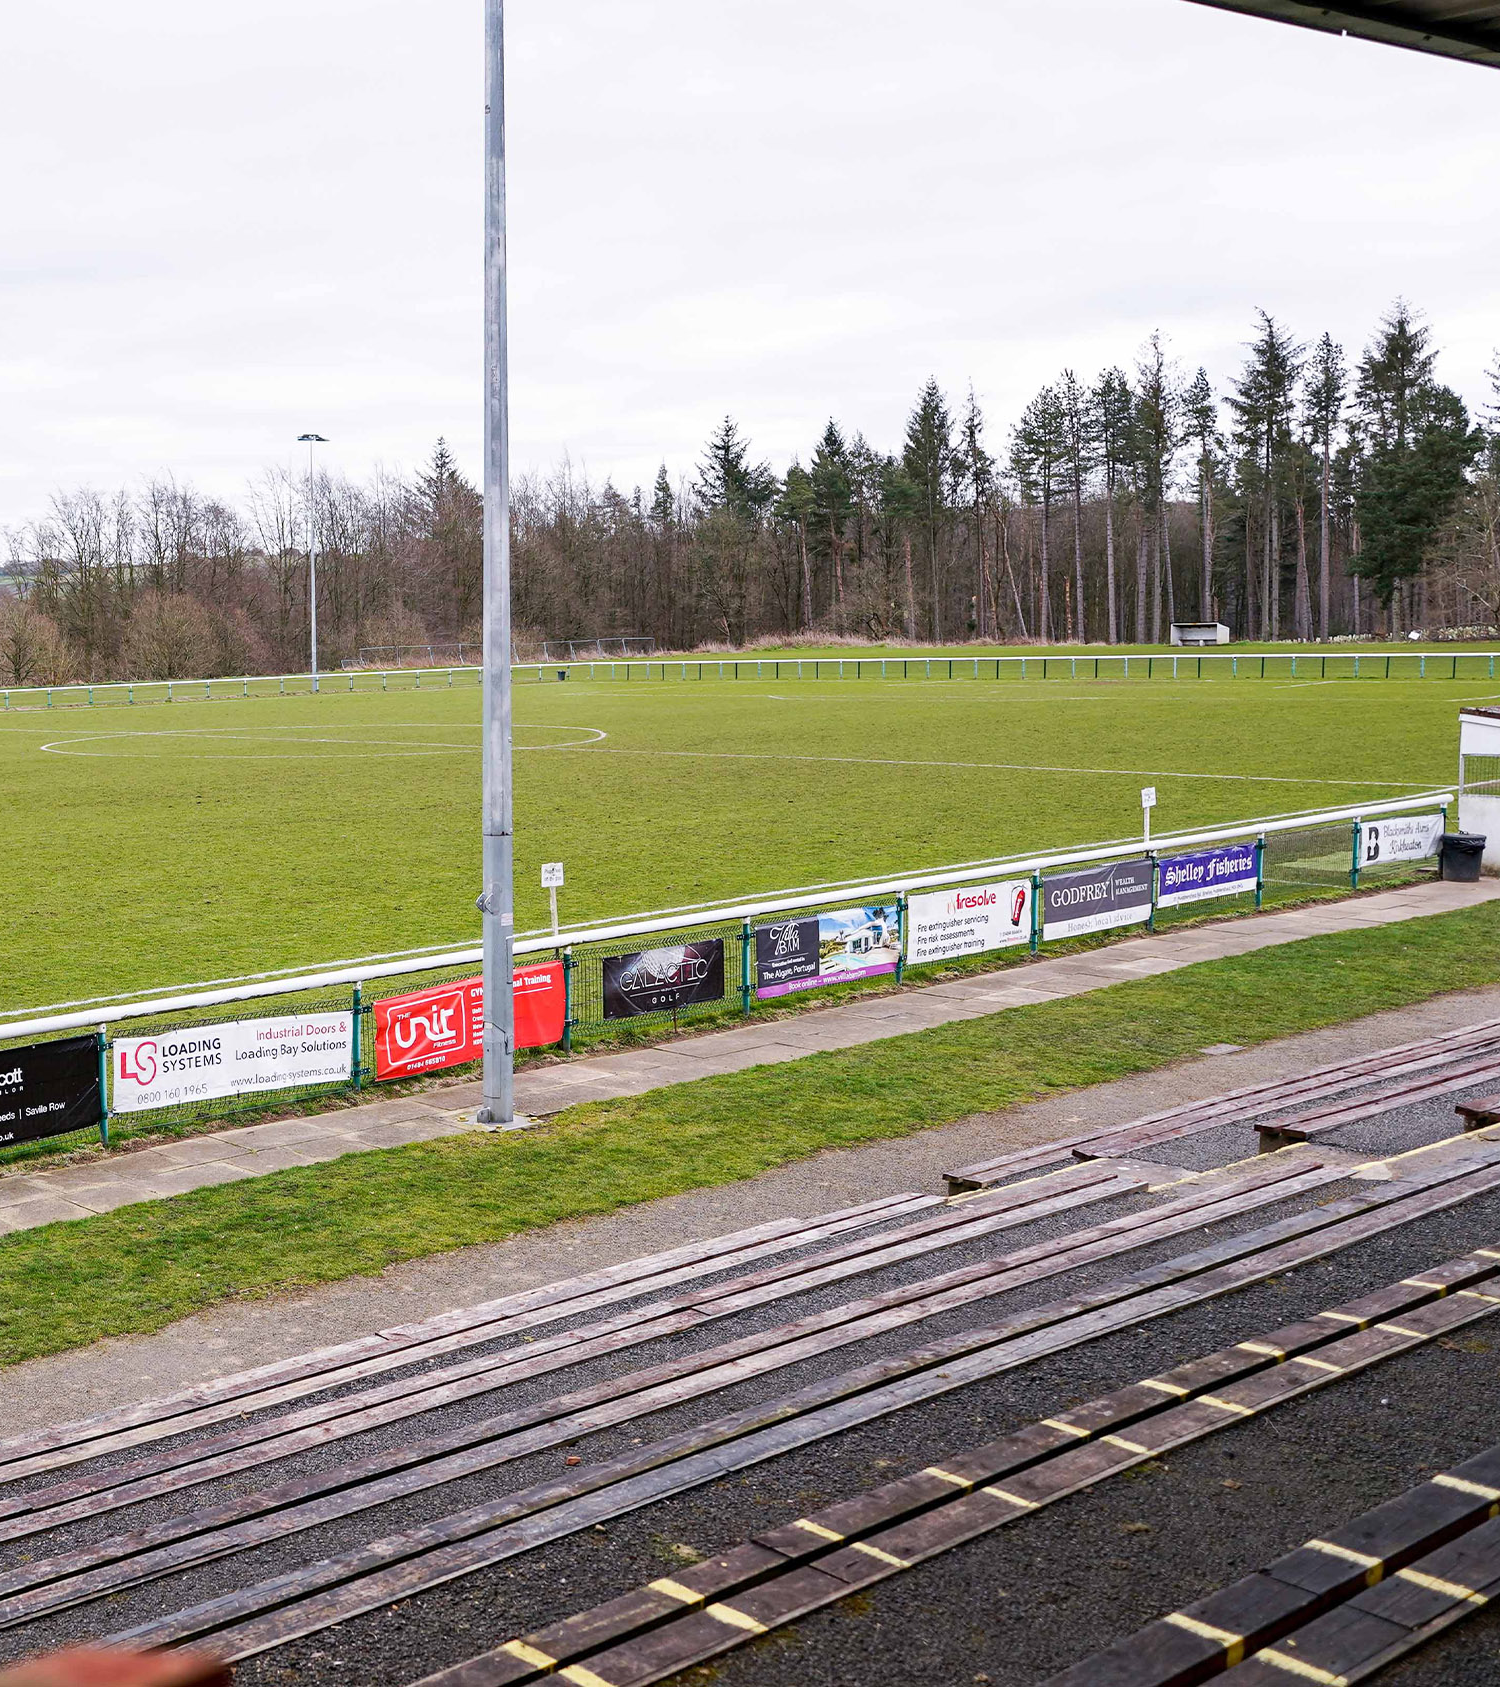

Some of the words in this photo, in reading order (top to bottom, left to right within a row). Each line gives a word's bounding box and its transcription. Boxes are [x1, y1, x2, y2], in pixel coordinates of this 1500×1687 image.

[1164, 862, 1204, 886] Shelley
[1206, 854, 1252, 880] Fisheries
[1114, 876, 1134, 886] WEALTH
[1116, 884, 1148, 896] MANAGEMENT
[1051, 882, 1110, 908] GODFREY
[918, 924, 928, 932] Fire
[928, 918, 964, 932] extinguisher
[964, 914, 988, 924] servicing
[1094, 916, 1112, 926] local
[917, 936, 928, 944] Fire
[928, 934, 939, 943] risk
[940, 928, 974, 941] assessments
[916, 948, 927, 957] Fire
[928, 942, 963, 955] extinguisher
[964, 938, 984, 948] training
[524, 974, 552, 986] Training
[620, 958, 708, 992] GALACTIC
[762, 971, 774, 980] The
[794, 962, 816, 974] Portugal
[788, 982, 800, 990] Book
[802, 979, 817, 988] online
[652, 992, 680, 1004] GOLF
[396, 1012, 412, 1020] THE
[256, 1026, 304, 1041] Industrial
[306, 1024, 336, 1036] Doors
[340, 1022, 347, 1032] &
[162, 1038, 222, 1058] LOADING
[236, 1046, 278, 1062] Loading
[281, 1044, 298, 1057] Bay
[301, 1040, 347, 1052] Solutions
[433, 1039, 456, 1048] Fitness
[162, 1052, 222, 1073] SYSTEMS
[230, 1064, 347, 1088] www.loading-systems.co.uk
[138, 1092, 160, 1104] 0800
[164, 1088, 180, 1100] 160
[184, 1083, 208, 1097] 1965
[49, 1102, 66, 1112] Row
